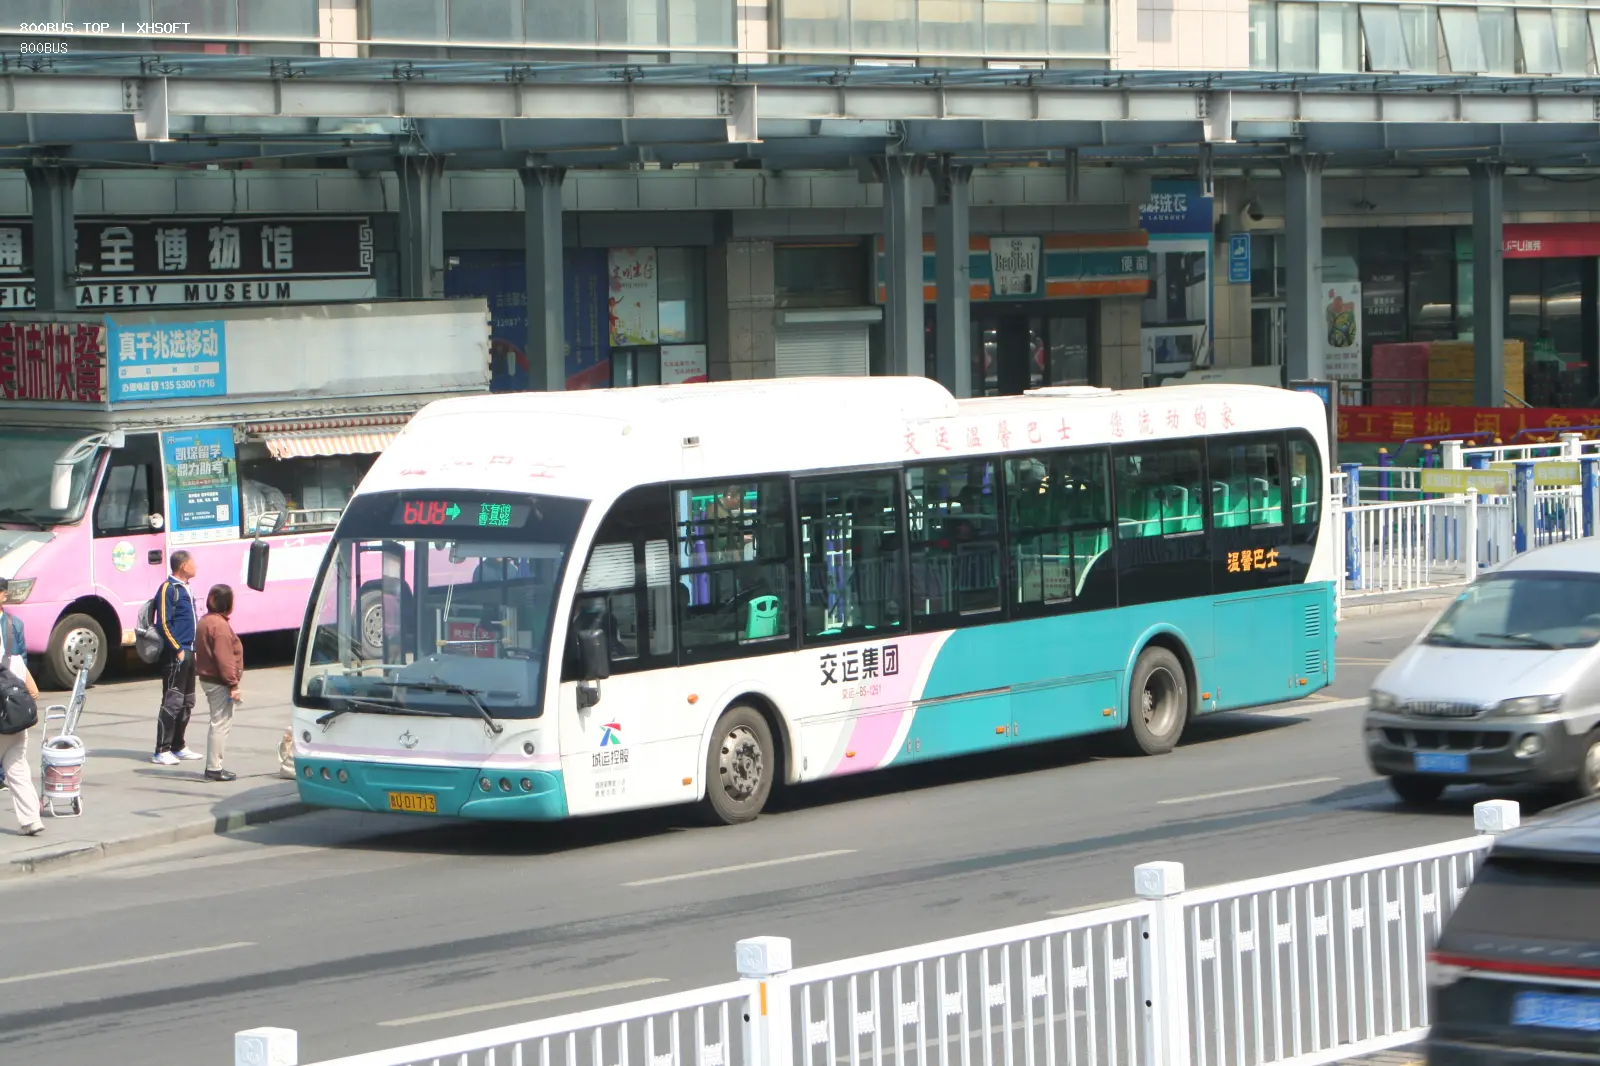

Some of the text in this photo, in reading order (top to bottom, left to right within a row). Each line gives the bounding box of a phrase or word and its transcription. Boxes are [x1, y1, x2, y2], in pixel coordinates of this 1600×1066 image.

[81, 285, 156, 304] AFETY
[185, 282, 291, 301] MUSEUM
[119, 327, 218, 361] 真千兆选移动
[160, 380, 174, 391] 135
[176, 379, 196, 390] 5300
[197, 377, 215, 388] 1716
[904, 402, 1235, 454] 交运温馨巴士 您流动的家
[1228, 548, 1280, 573] 温馨巴士
[820, 644, 899, 686] 交运集团
[592, 748, 629, 767] 城运控股
